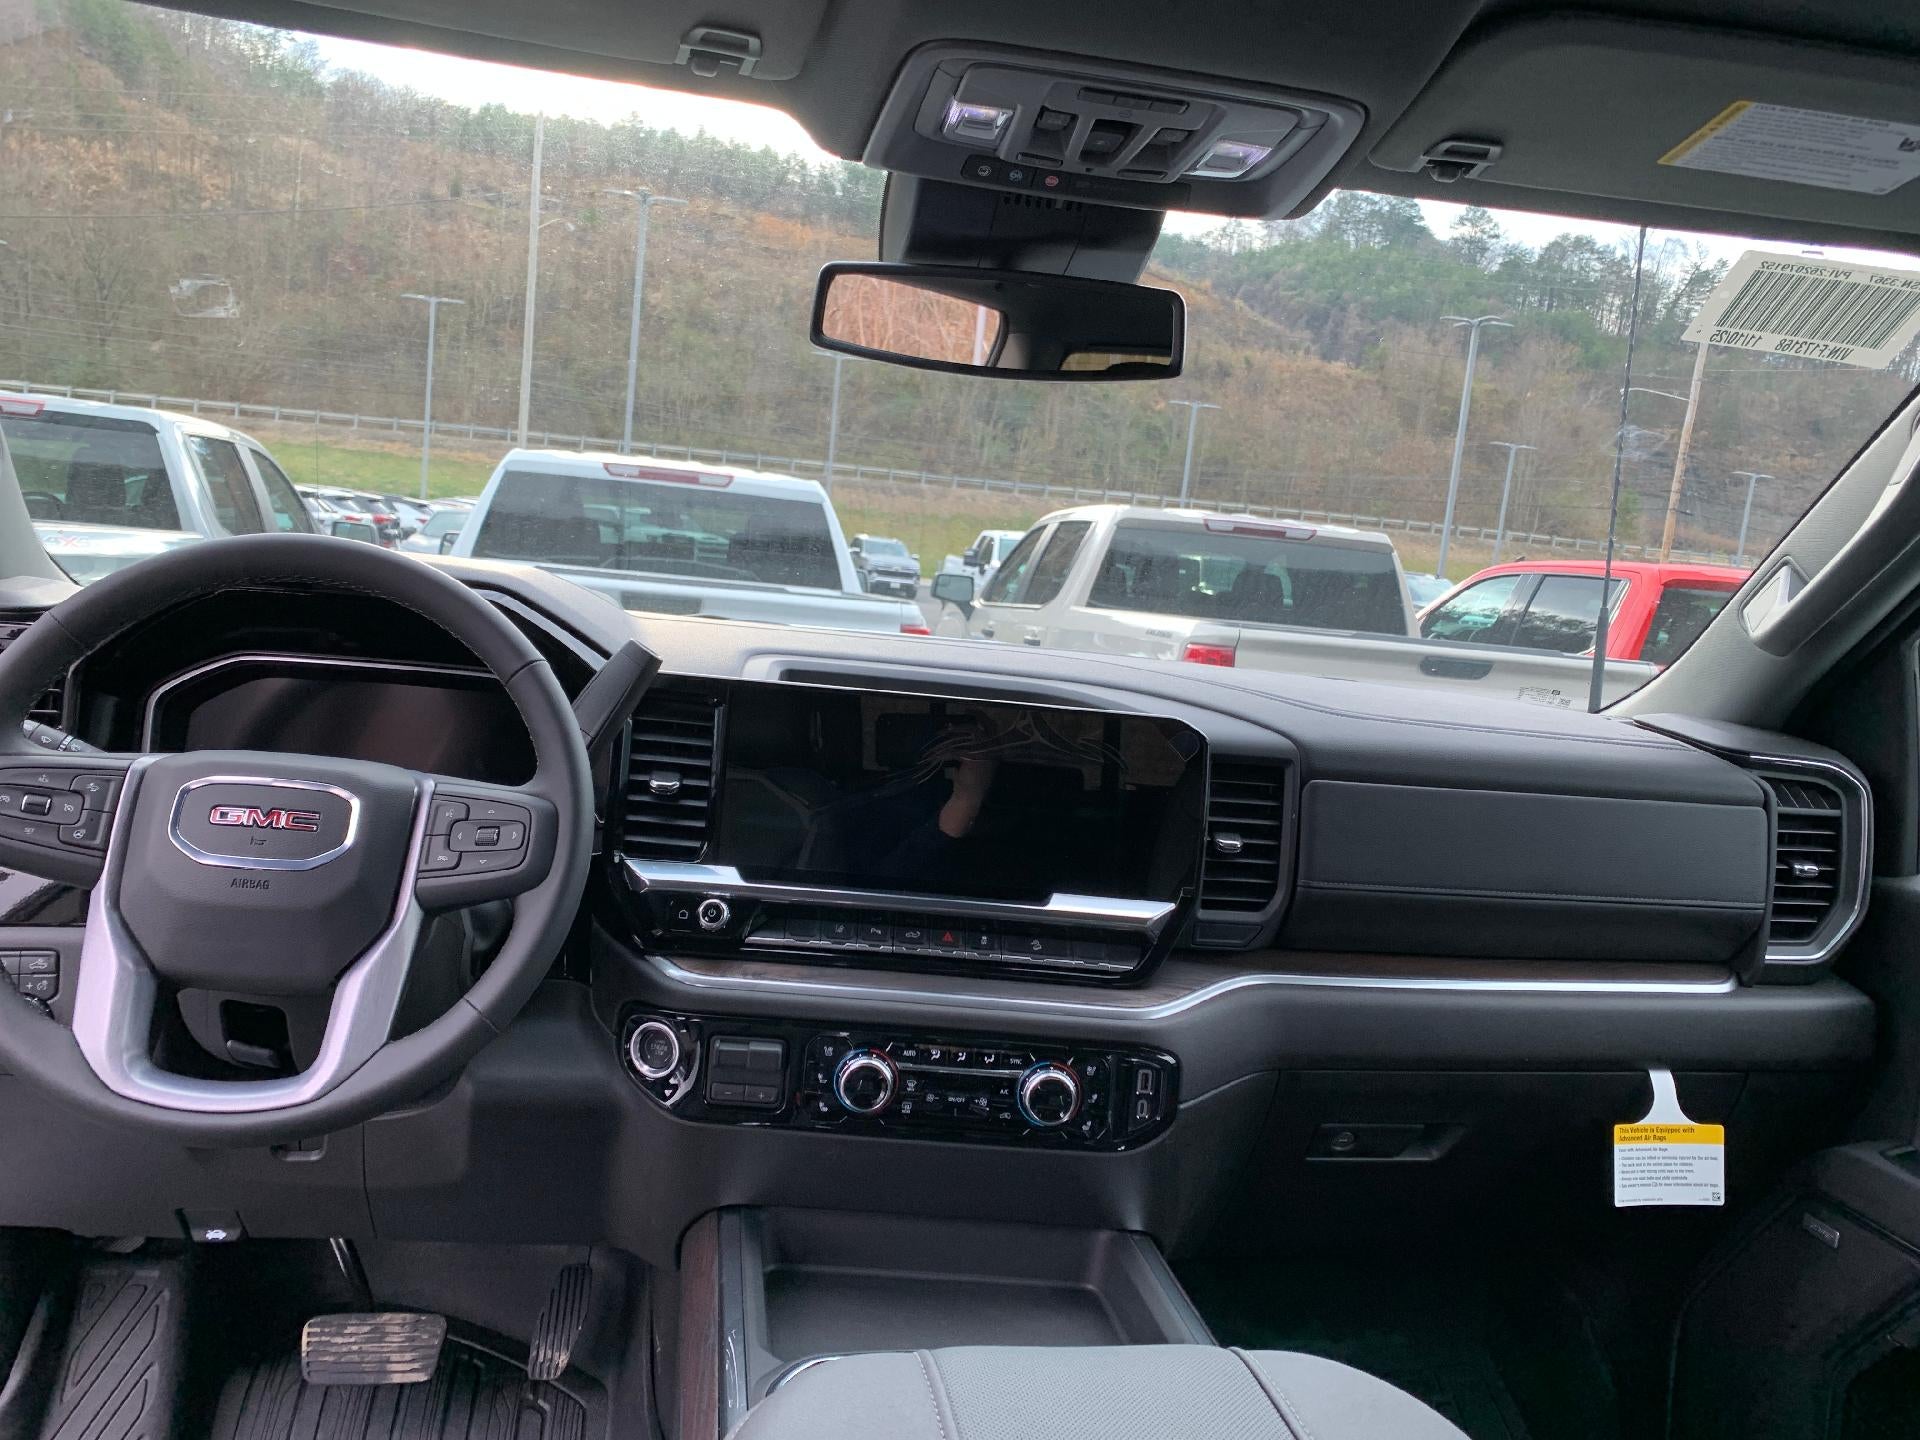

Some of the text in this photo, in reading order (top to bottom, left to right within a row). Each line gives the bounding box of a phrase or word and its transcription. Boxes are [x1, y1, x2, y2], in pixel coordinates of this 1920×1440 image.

[209, 804, 320, 832] GMC
[230, 879, 270, 890] AIRBAG
[1630, 1126, 1649, 1134] Vehicle
[1653, 1134, 1667, 1142] Bags
